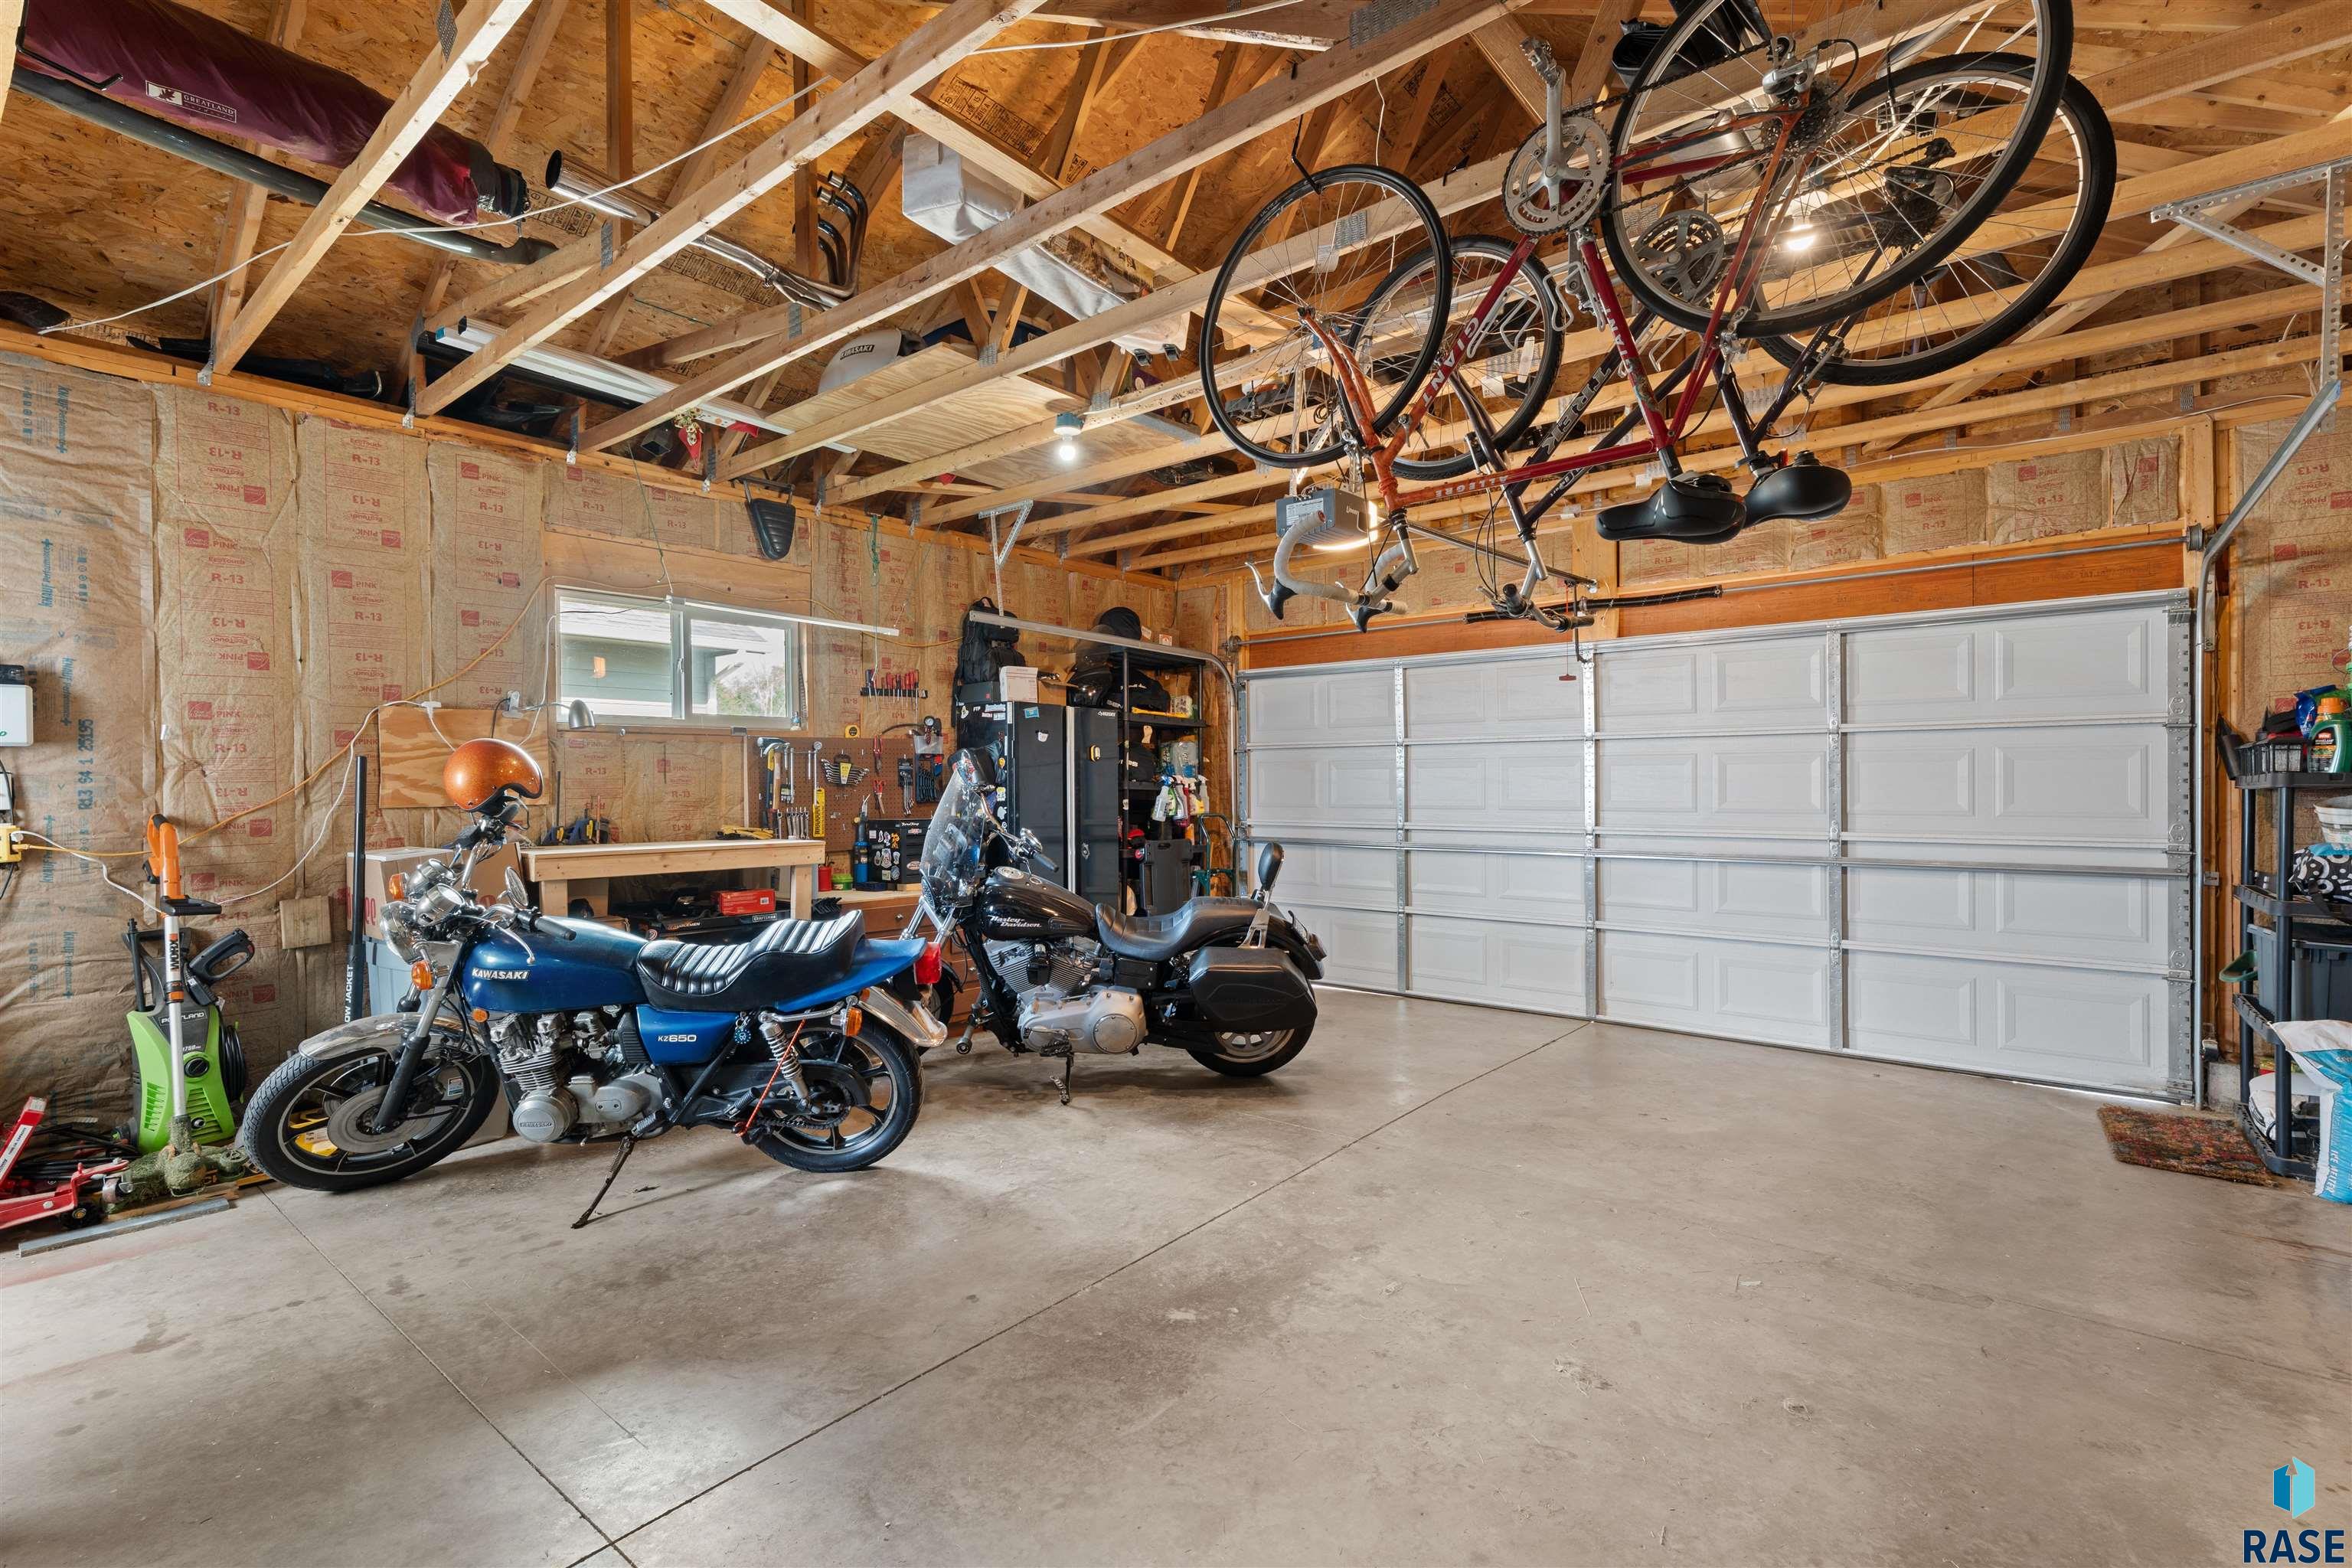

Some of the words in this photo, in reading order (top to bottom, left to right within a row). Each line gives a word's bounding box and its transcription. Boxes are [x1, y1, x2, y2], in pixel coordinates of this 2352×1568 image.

[184, 94, 234, 115] GREATLAND
[840, 345, 874, 360] KAWASAKI
[1423, 317, 1480, 407] GIANT
[207, 401, 240, 416] R-13
[1542, 367, 1612, 456] TREK
[209, 447, 242, 460] R-13
[352, 454, 381, 466] R-13
[2298, 464, 2329, 475] R-13
[353, 495, 381, 507] R-13
[2037, 495, 2064, 505] R-13
[479, 501, 503, 513] R-13
[583, 501, 604, 512] R-13
[667, 520, 687, 529] R-13
[1922, 521, 1946, 531] R-13
[478, 541, 502, 551] R-13
[211, 573, 244, 584] R-13
[2298, 579, 2331, 589] R-13
[354, 611, 382, 622] R-13
[212, 617, 246, 628] R-13
[2298, 619, 2330, 630] R-13
[355, 652, 383, 662] R-13
[479, 686, 501, 695] R-13
[214, 743, 247, 753] R-13
[585, 767, 606, 776] R-13
[216, 787, 247, 797] R-13
[170, 934, 180, 970] WORX
[472, 968, 529, 979] KAWASAKI
[345, 965, 354, 1004] JACKET
